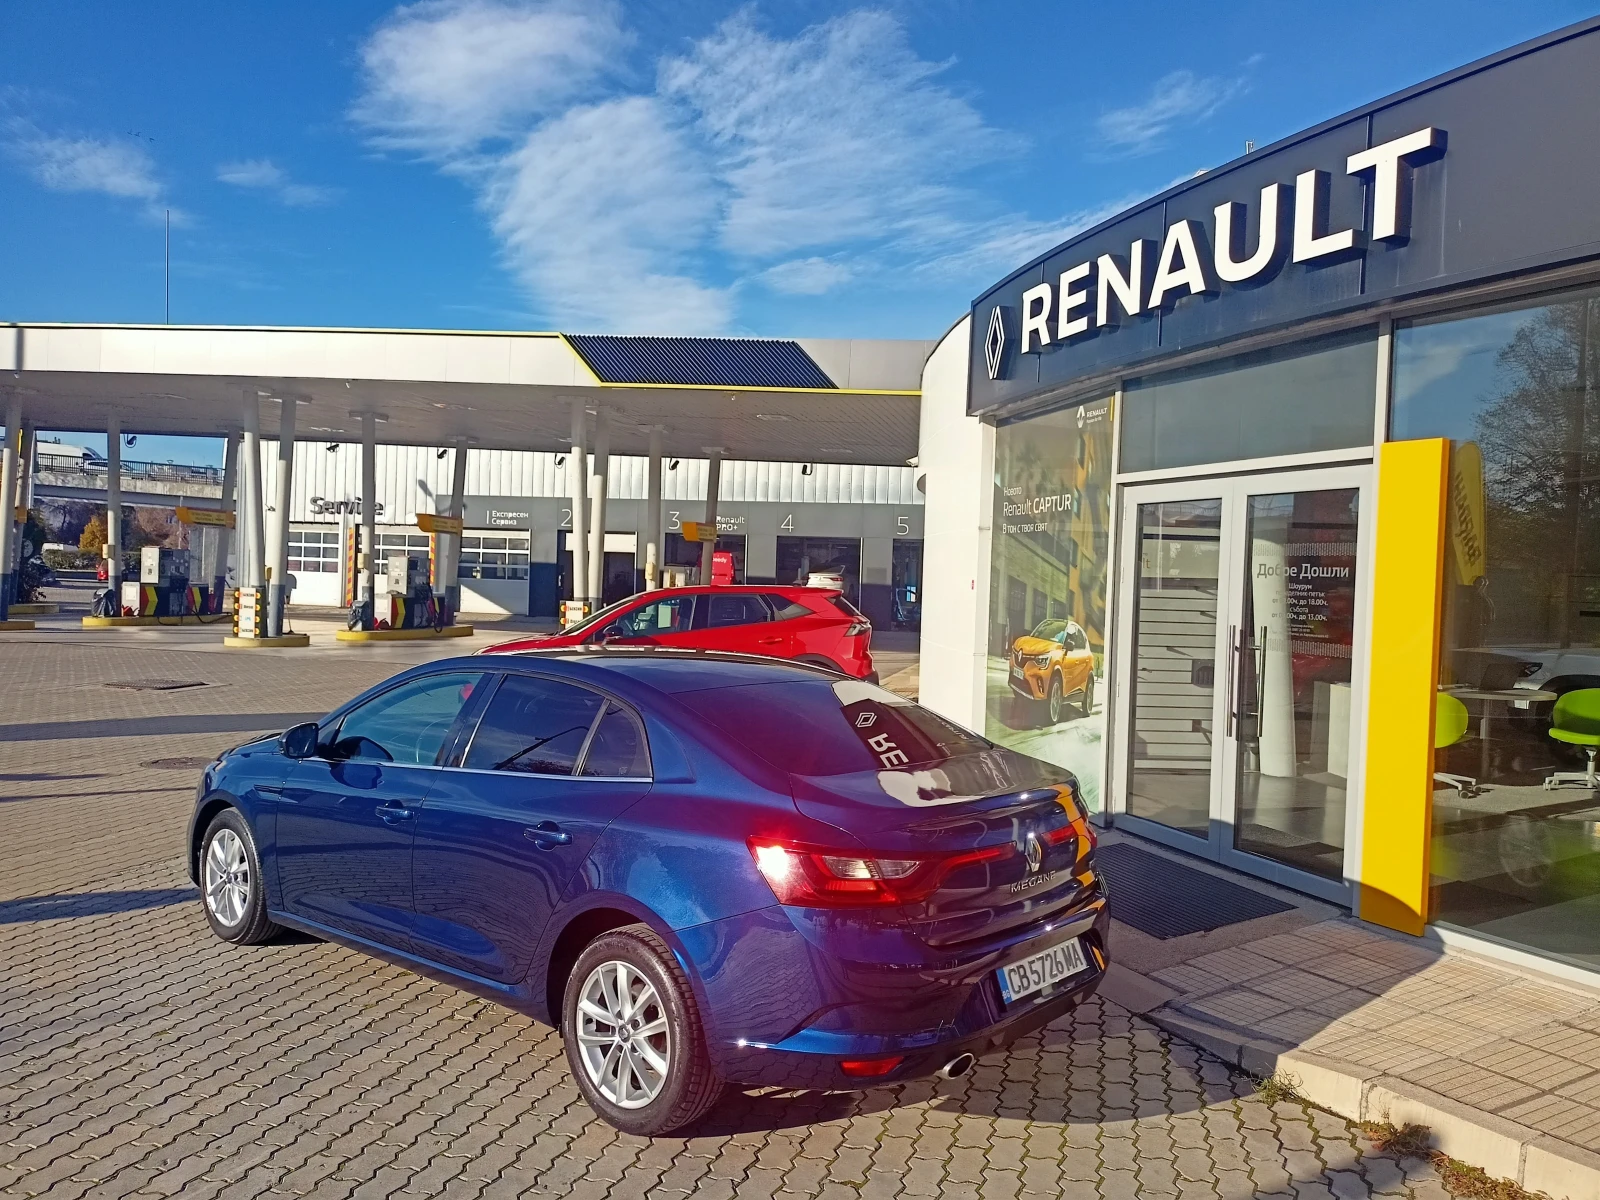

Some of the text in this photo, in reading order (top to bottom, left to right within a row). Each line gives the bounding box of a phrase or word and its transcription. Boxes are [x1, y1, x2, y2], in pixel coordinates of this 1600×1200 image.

[1020, 126, 1440, 355] RENAULT
[1086, 407, 1108, 418] RENAULT
[1003, 487, 1023, 496] Новото
[310, 496, 384, 515] Servie
[1003, 494, 1072, 517] Renault CAPTUR
[491, 510, 529, 519] Експресен
[491, 518, 517, 526] Сервиз
[561, 508, 572, 527] 2
[668, 511, 681, 530] 3
[716, 515, 745, 524] Renault
[716, 523, 738, 531] PRO+
[780, 514, 795, 533] 4
[896, 516, 910, 535] 5
[1002, 524, 1007, 534] В
[1256, 563, 1349, 580] Добре Дошли
[1288, 583, 1313, 591] Шоурум
[1011, 870, 1056, 893] MEGANE
